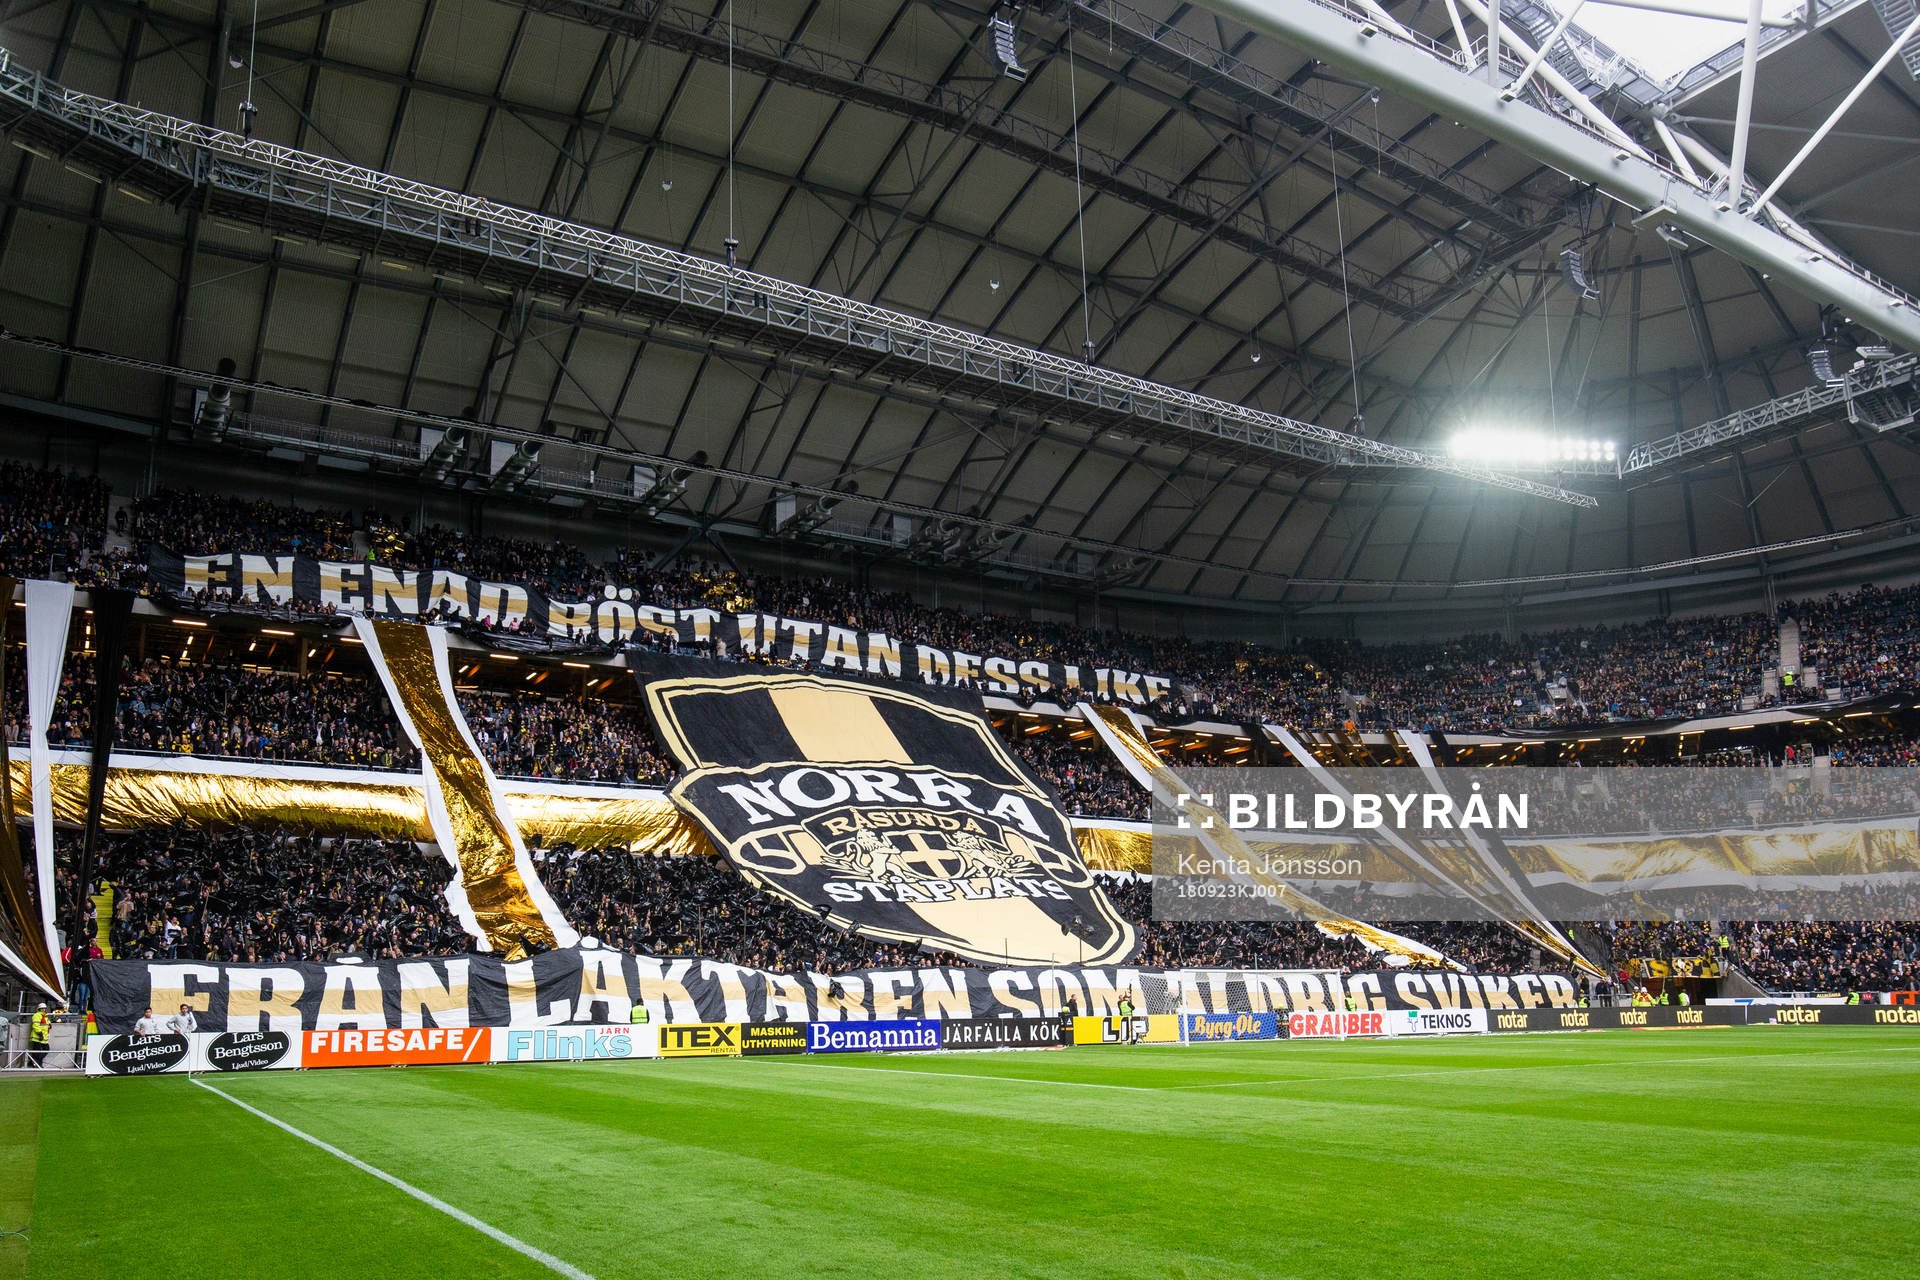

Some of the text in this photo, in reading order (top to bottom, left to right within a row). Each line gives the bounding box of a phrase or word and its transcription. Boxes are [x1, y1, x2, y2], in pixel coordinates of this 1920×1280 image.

[184, 553, 295, 606] EN
[319, 560, 529, 628] ENAD
[737, 613, 903, 678] UTAN
[717, 766, 1050, 842] NORRA
[822, 806, 988, 836] RÅSUNDA
[822, 875, 1073, 902] STÅPLATS
[147, 957, 470, 1034] FRÅN
[987, 968, 1142, 1019] SOM
[1290, 1012, 1384, 1037] GRABBER
[1420, 1012, 1473, 1029] TEKNOS
[1497, 1010, 1528, 1029] notar
[1560, 1011, 1590, 1027] notar
[1619, 1008, 1648, 1025] notar
[1676, 1007, 1703, 1024] notar
[1776, 1006, 1822, 1024] notar
[128, 1034, 162, 1047] Lars
[232, 1032, 264, 1044] Lars
[660, 1026, 737, 1048] ITEX
[750, 1027, 799, 1037] MASKIN-
[810, 1022, 938, 1050] Bemannia
[943, 1022, 1060, 1043] JÄRFÄLLA KÖK
[108, 1043, 182, 1063] Bengtsson
[214, 1041, 283, 1060] Bengtsson
[507, 1029, 633, 1060] Flinks
[742, 1038, 807, 1049] UTHYRNING
[127, 1061, 167, 1074] Ljud/Video
[231, 1058, 269, 1070] Ljud/Video
